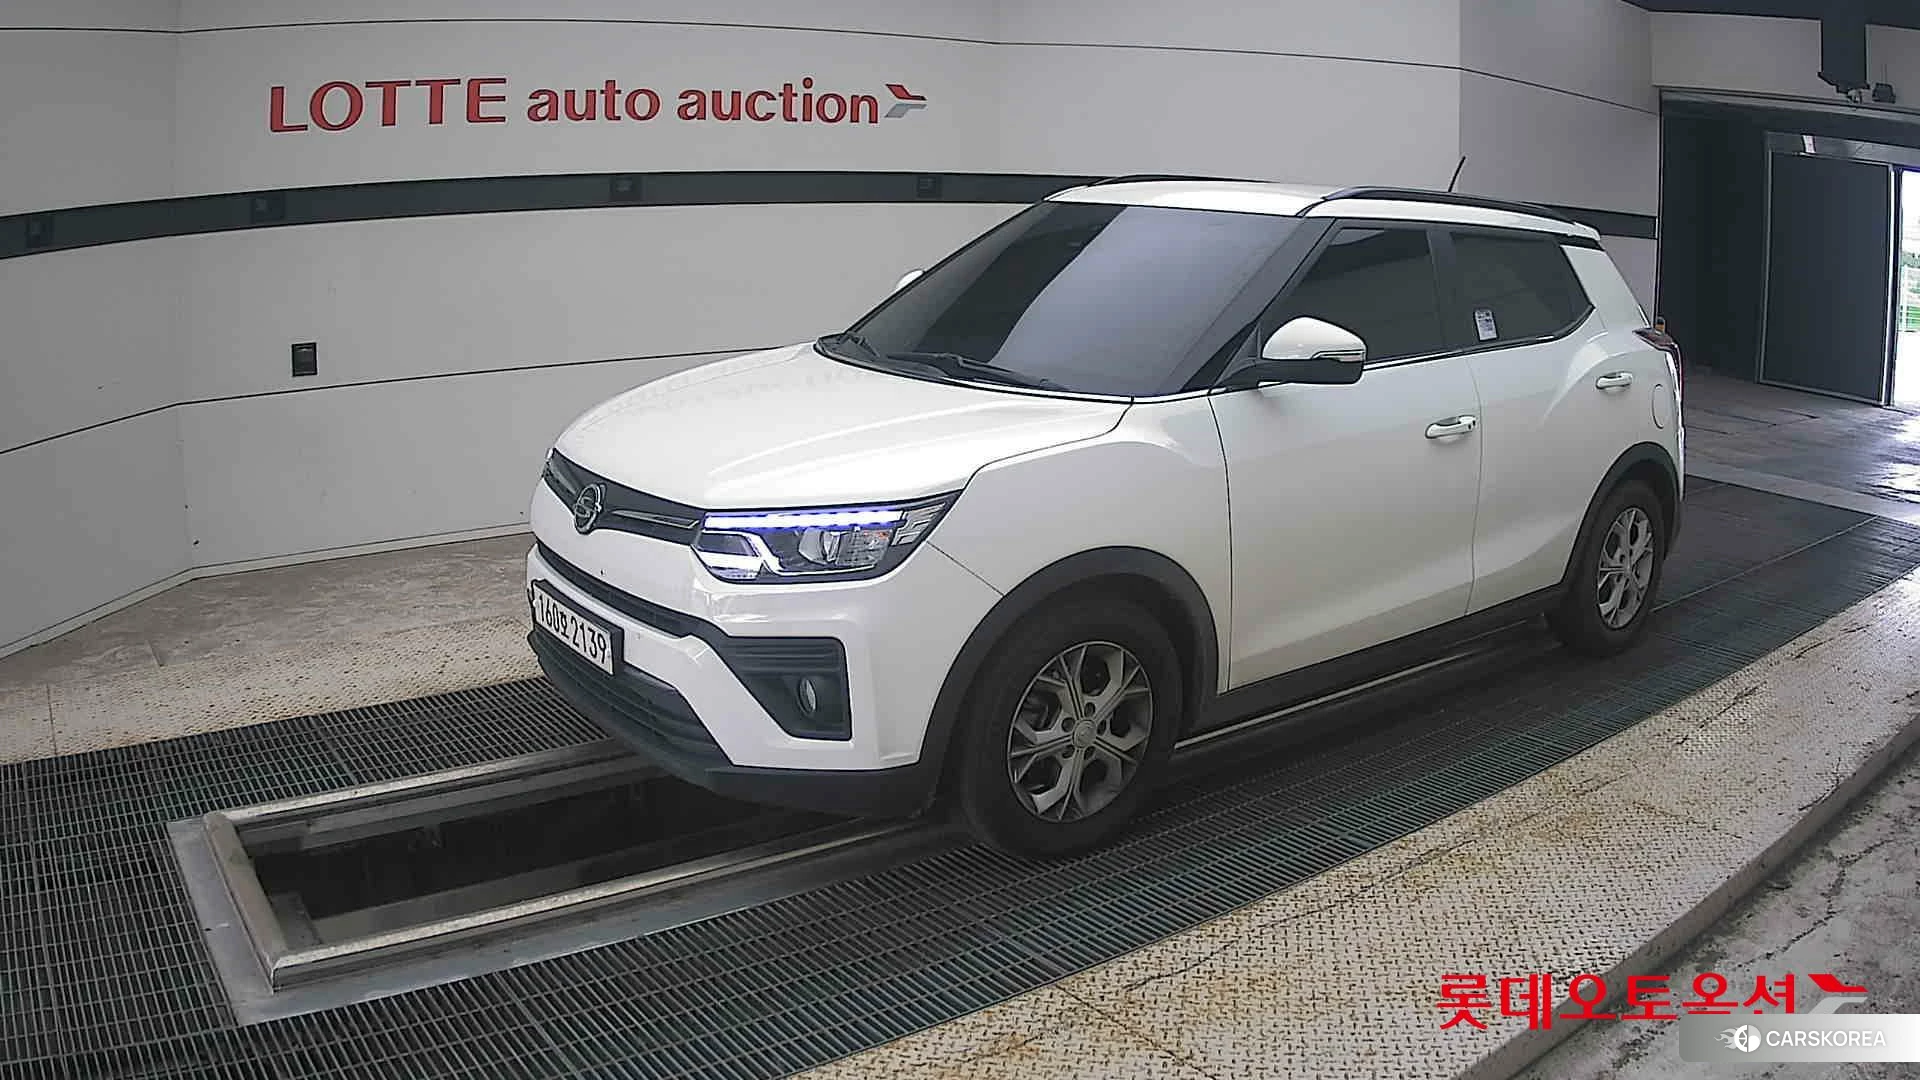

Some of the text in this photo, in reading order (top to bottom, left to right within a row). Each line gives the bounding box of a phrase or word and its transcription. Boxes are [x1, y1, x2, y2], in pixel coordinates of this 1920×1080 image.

[270, 78, 880, 132] LOTTE auto auction
[570, 615, 607, 665] 2139
